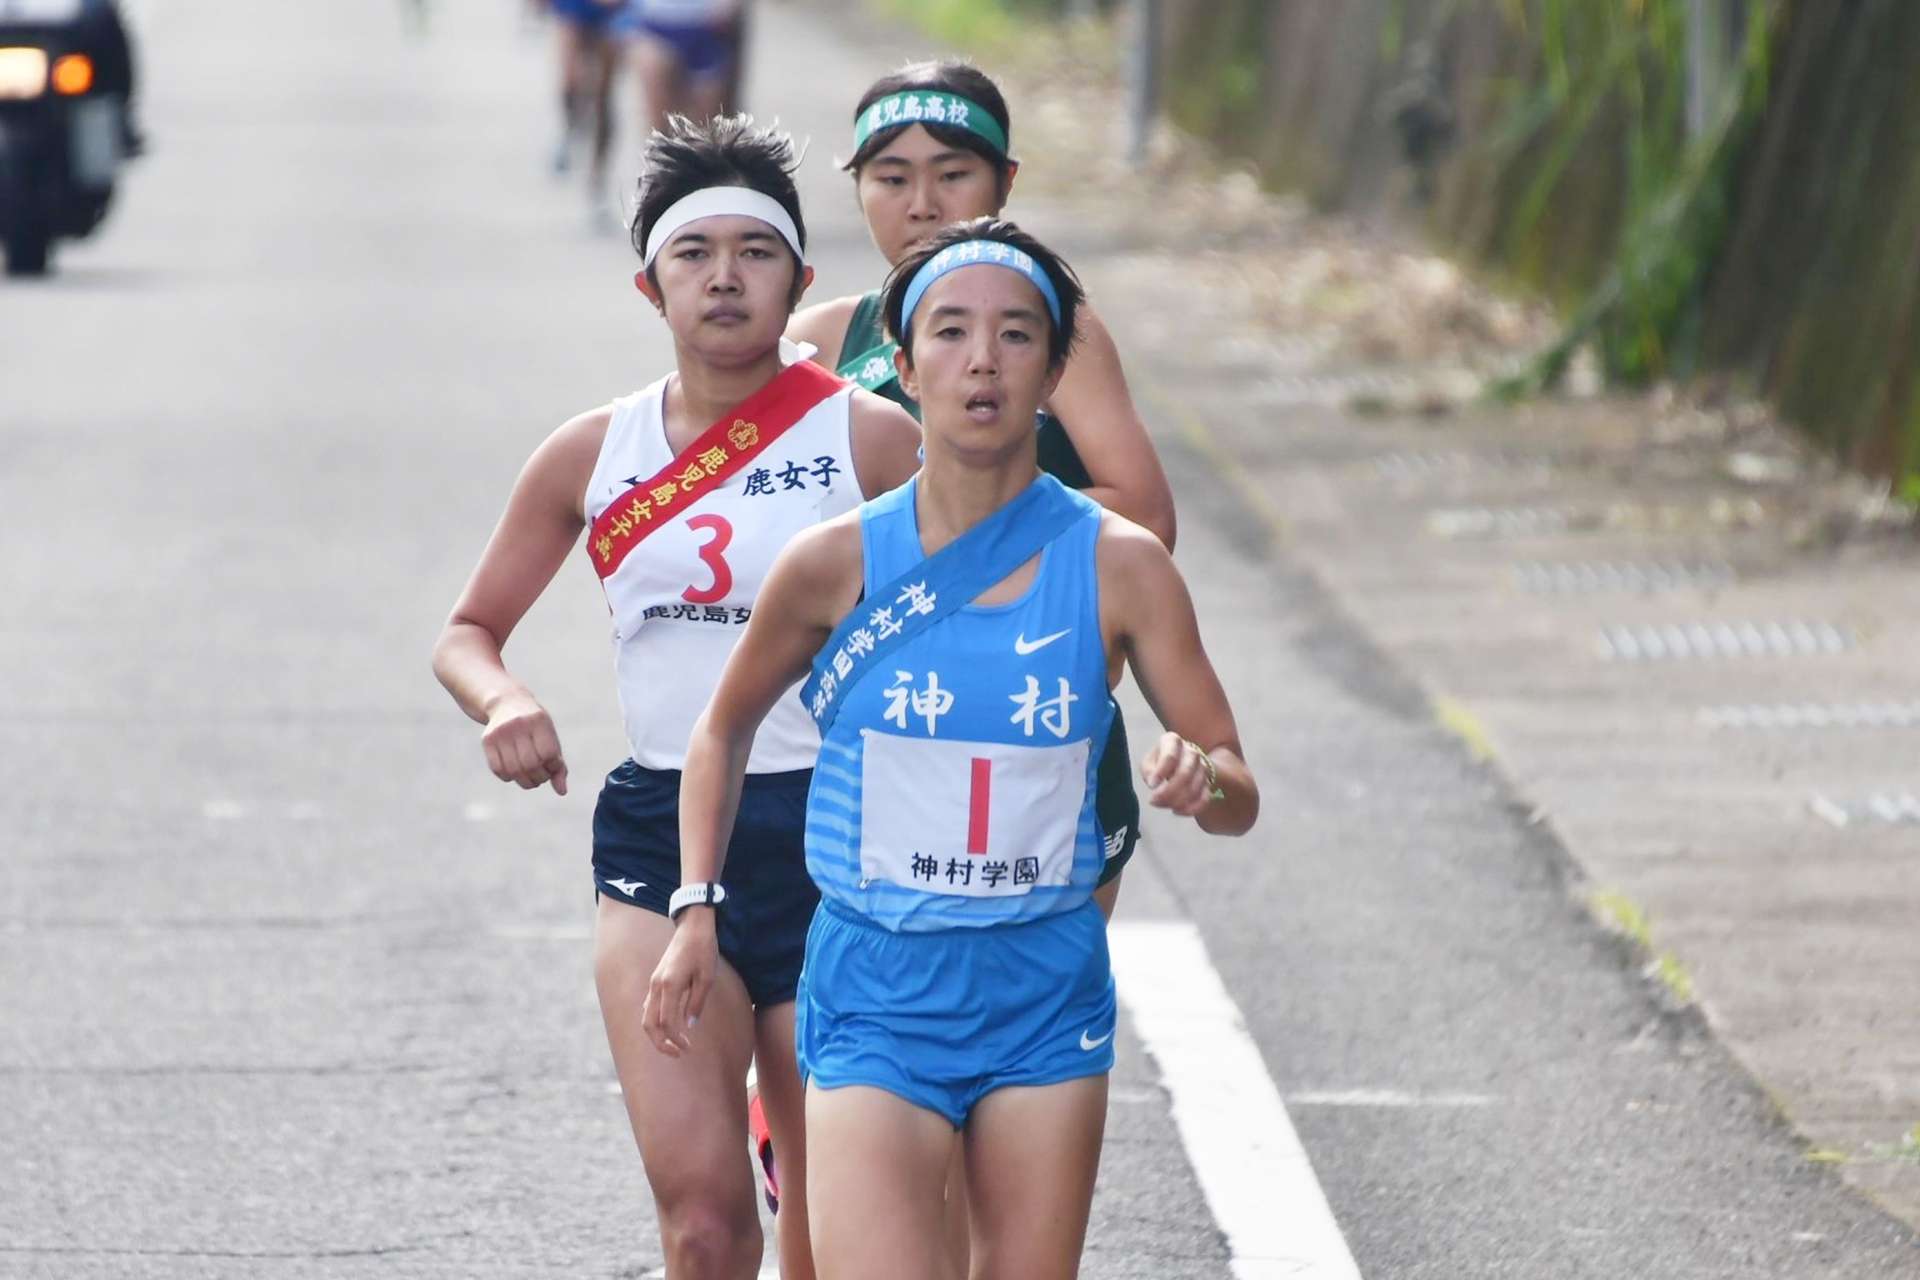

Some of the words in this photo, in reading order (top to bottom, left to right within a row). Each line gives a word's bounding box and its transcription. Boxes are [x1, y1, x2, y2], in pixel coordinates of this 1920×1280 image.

[930, 240, 1033, 273] 神村学園
[742, 455, 841, 496] 鹿女子
[681, 513, 733, 604] 3
[967, 757, 991, 855] 1
[912, 852, 1039, 887] 神村学園
